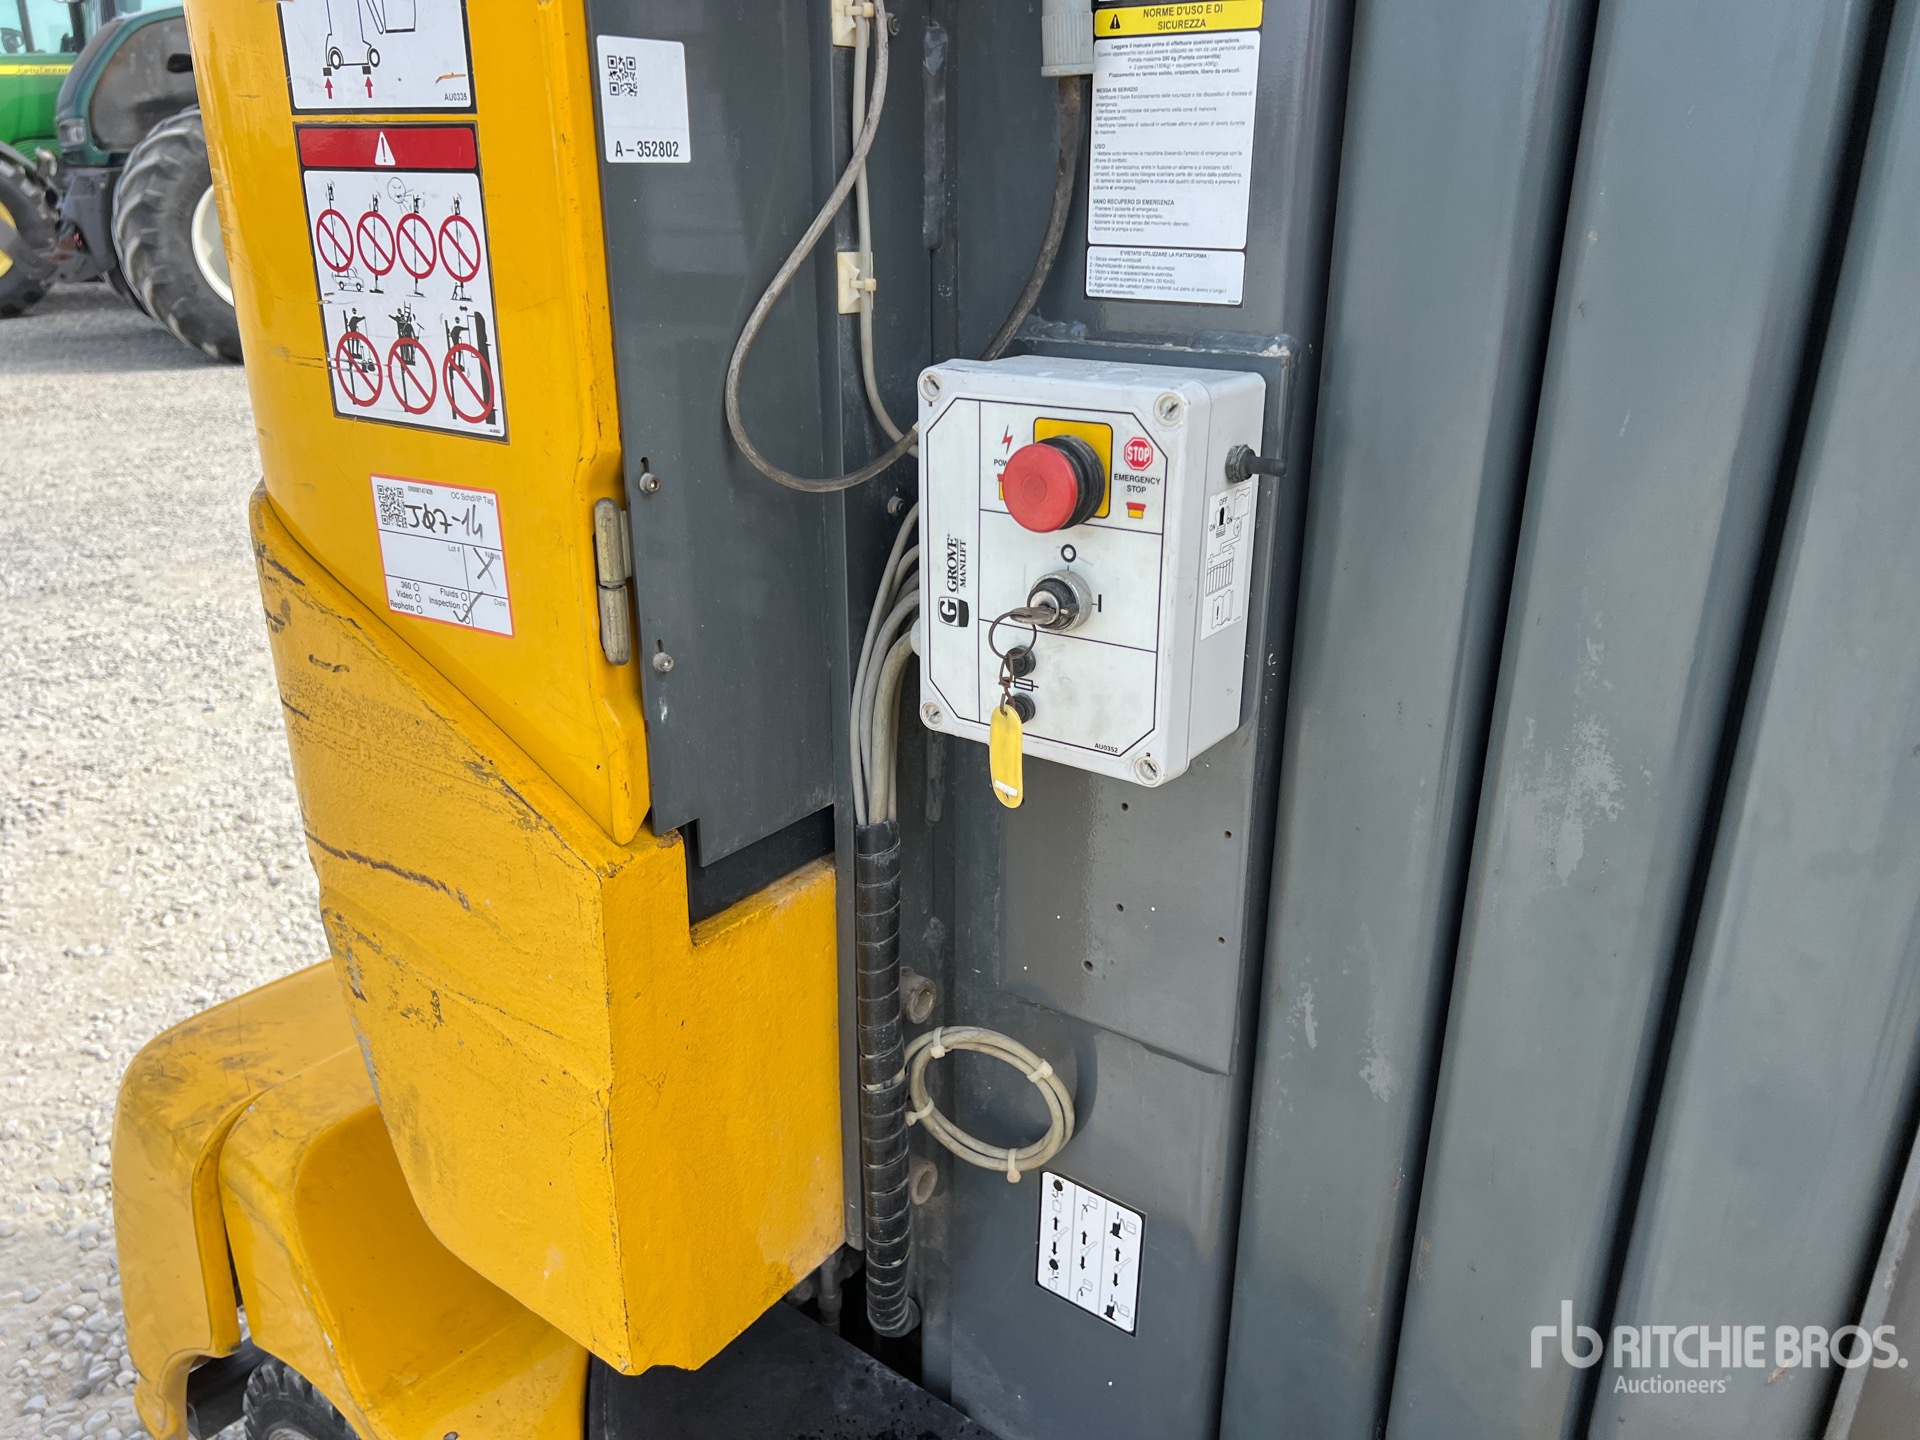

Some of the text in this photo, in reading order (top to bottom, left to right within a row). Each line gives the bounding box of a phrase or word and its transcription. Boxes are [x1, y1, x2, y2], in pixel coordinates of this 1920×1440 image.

[1143, 3, 1223, 18] NORME D'USO E DI
[1157, 19, 1207, 30] SICUREZZA
[444, 92, 467, 101] AU0335
[1127, 446, 1150, 462] STOP
[1113, 473, 1161, 485] EMERGENCY
[1127, 484, 1146, 493] STOP
[450, 491, 460, 500] OC
[483, 496, 494, 506] Tag
[1219, 496, 1228, 506] OFF
[448, 544, 456, 552] Lot
[485, 551, 501, 560] Notes
[946, 537, 957, 592] GROVE
[959, 539, 967, 588] MANLIFT
[400, 581, 411, 589] 360
[395, 589, 413, 600] Video
[440, 587, 459, 599] Fluids
[390, 599, 415, 611] Rephoto
[429, 596, 461, 610] Inspection
[494, 598, 507, 608] Date
[1094, 743, 1118, 753] AU0352
